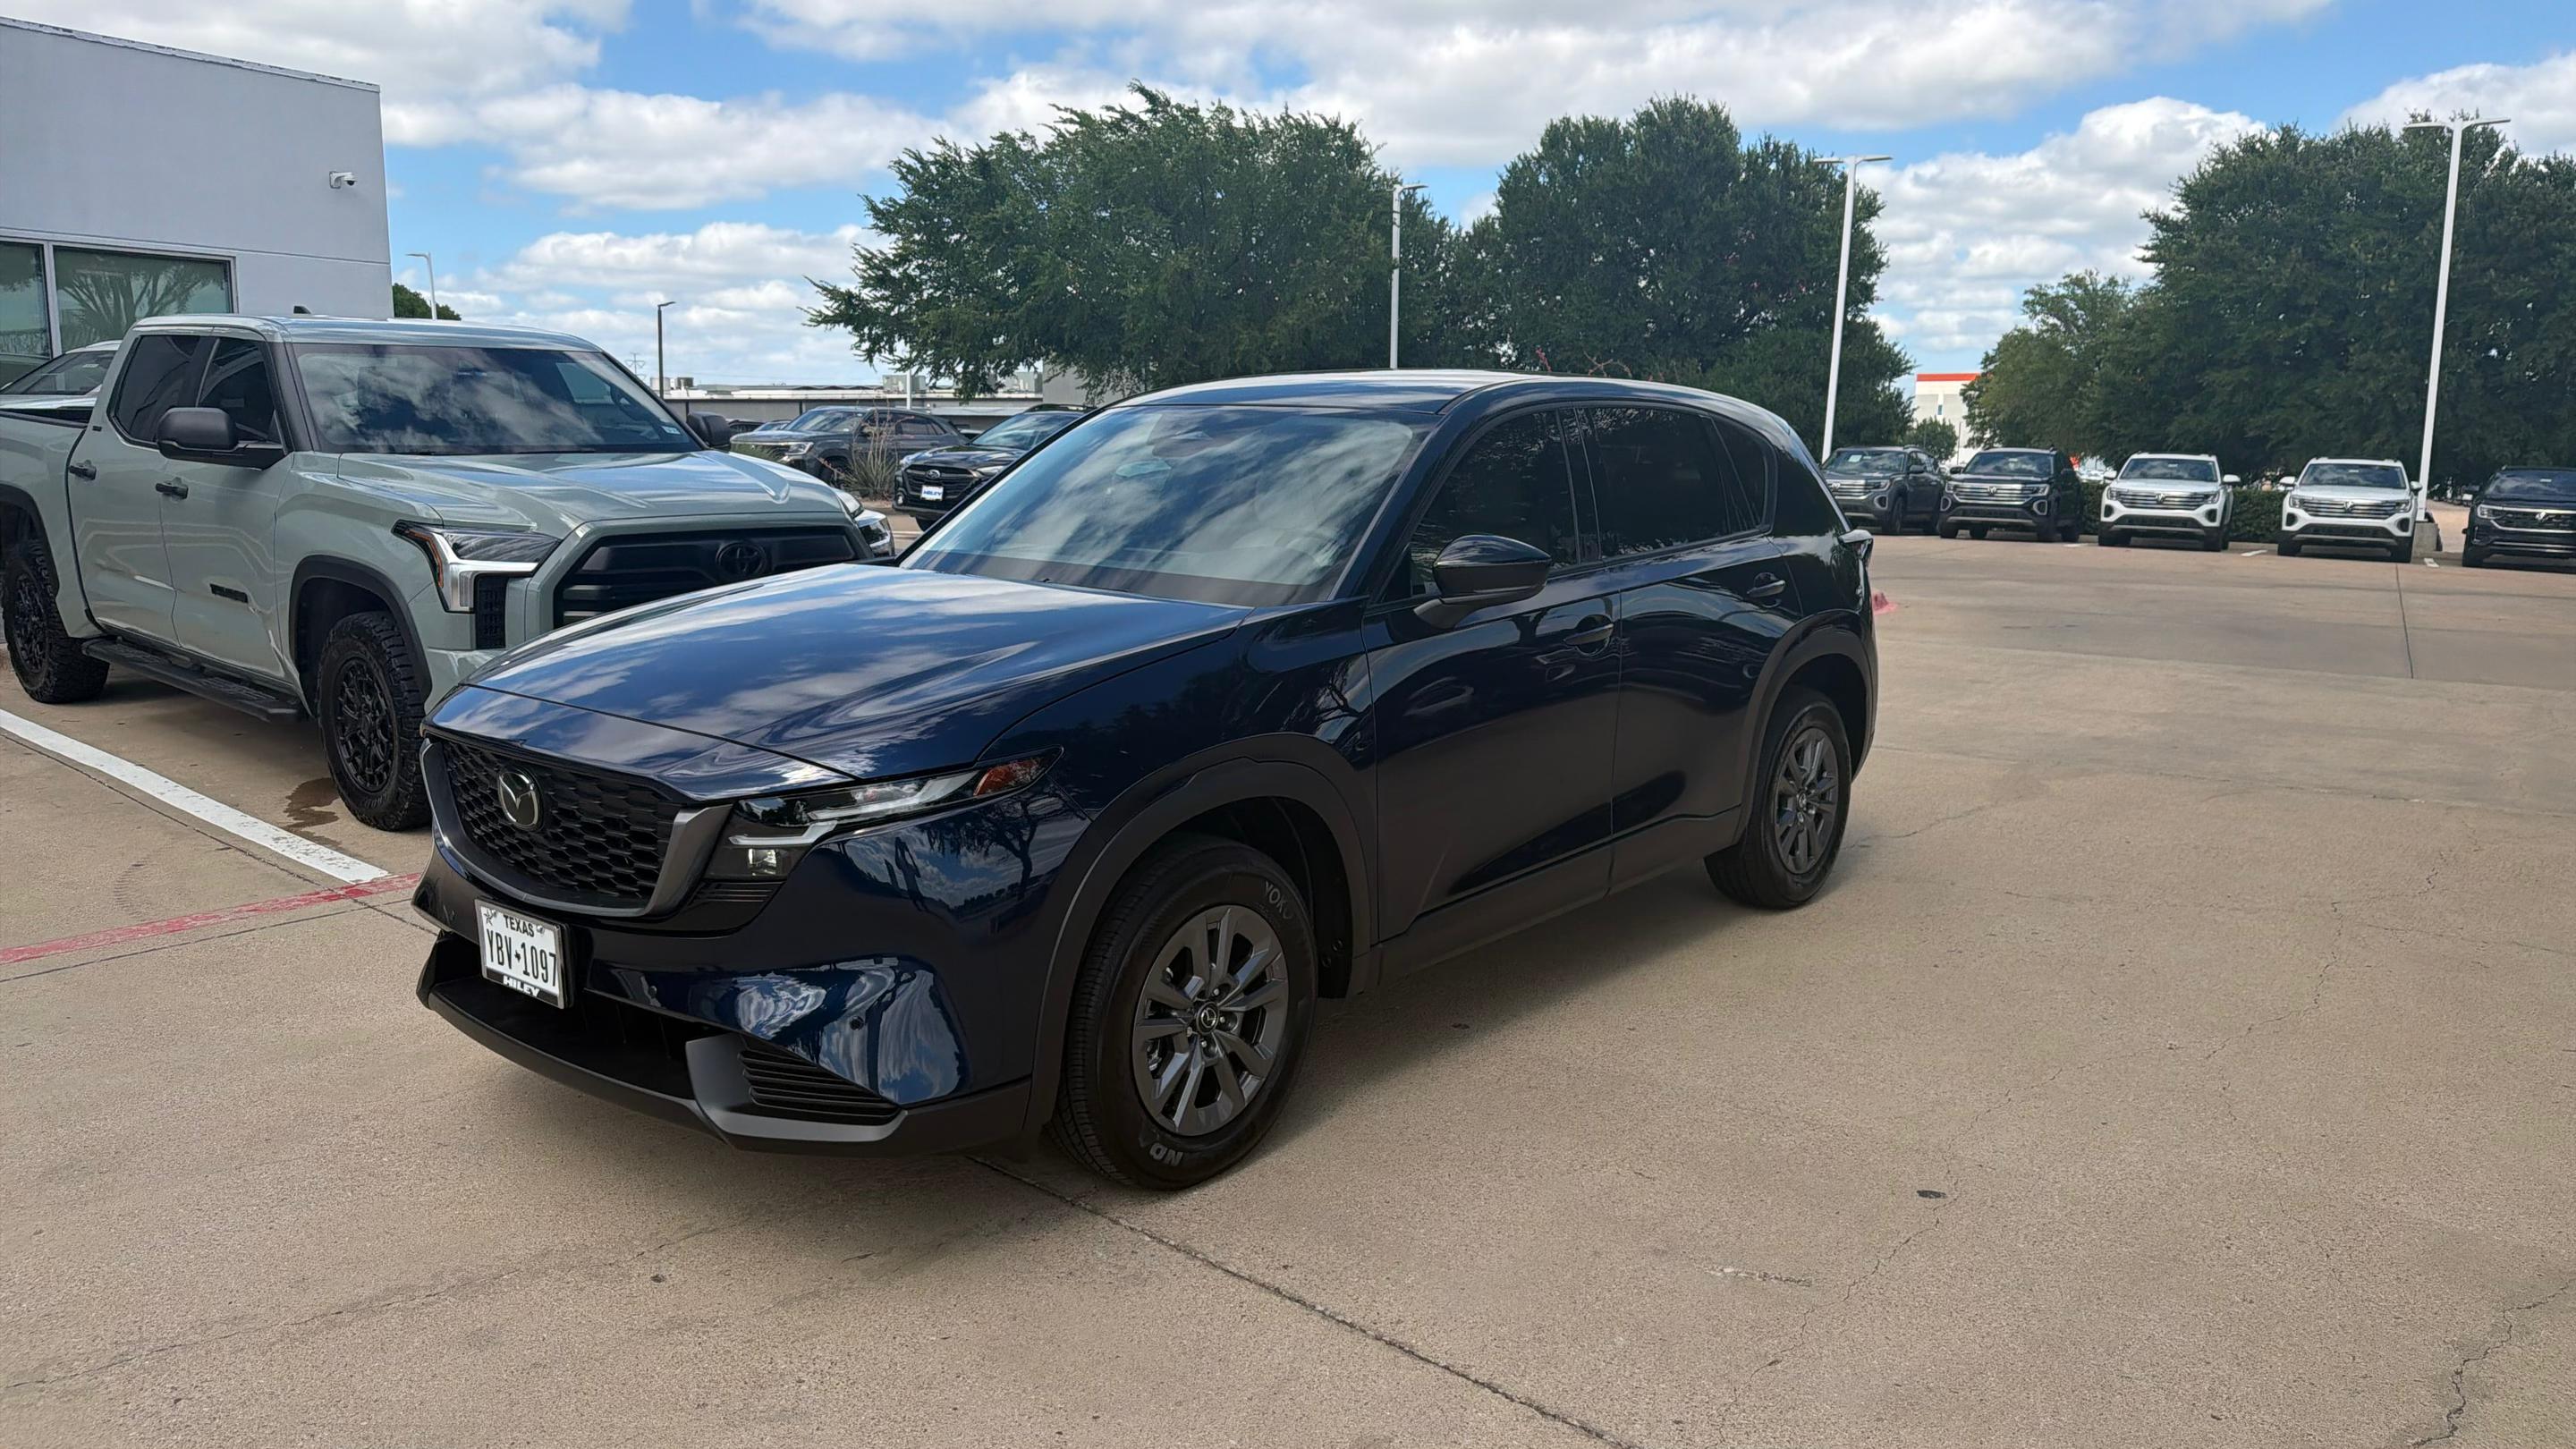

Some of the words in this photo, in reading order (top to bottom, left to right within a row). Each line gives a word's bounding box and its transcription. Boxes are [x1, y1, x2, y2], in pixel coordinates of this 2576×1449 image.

[503, 915, 535, 937] TEXAS
[521, 942, 557, 987] 1097
[503, 975, 540, 997] HILEY
